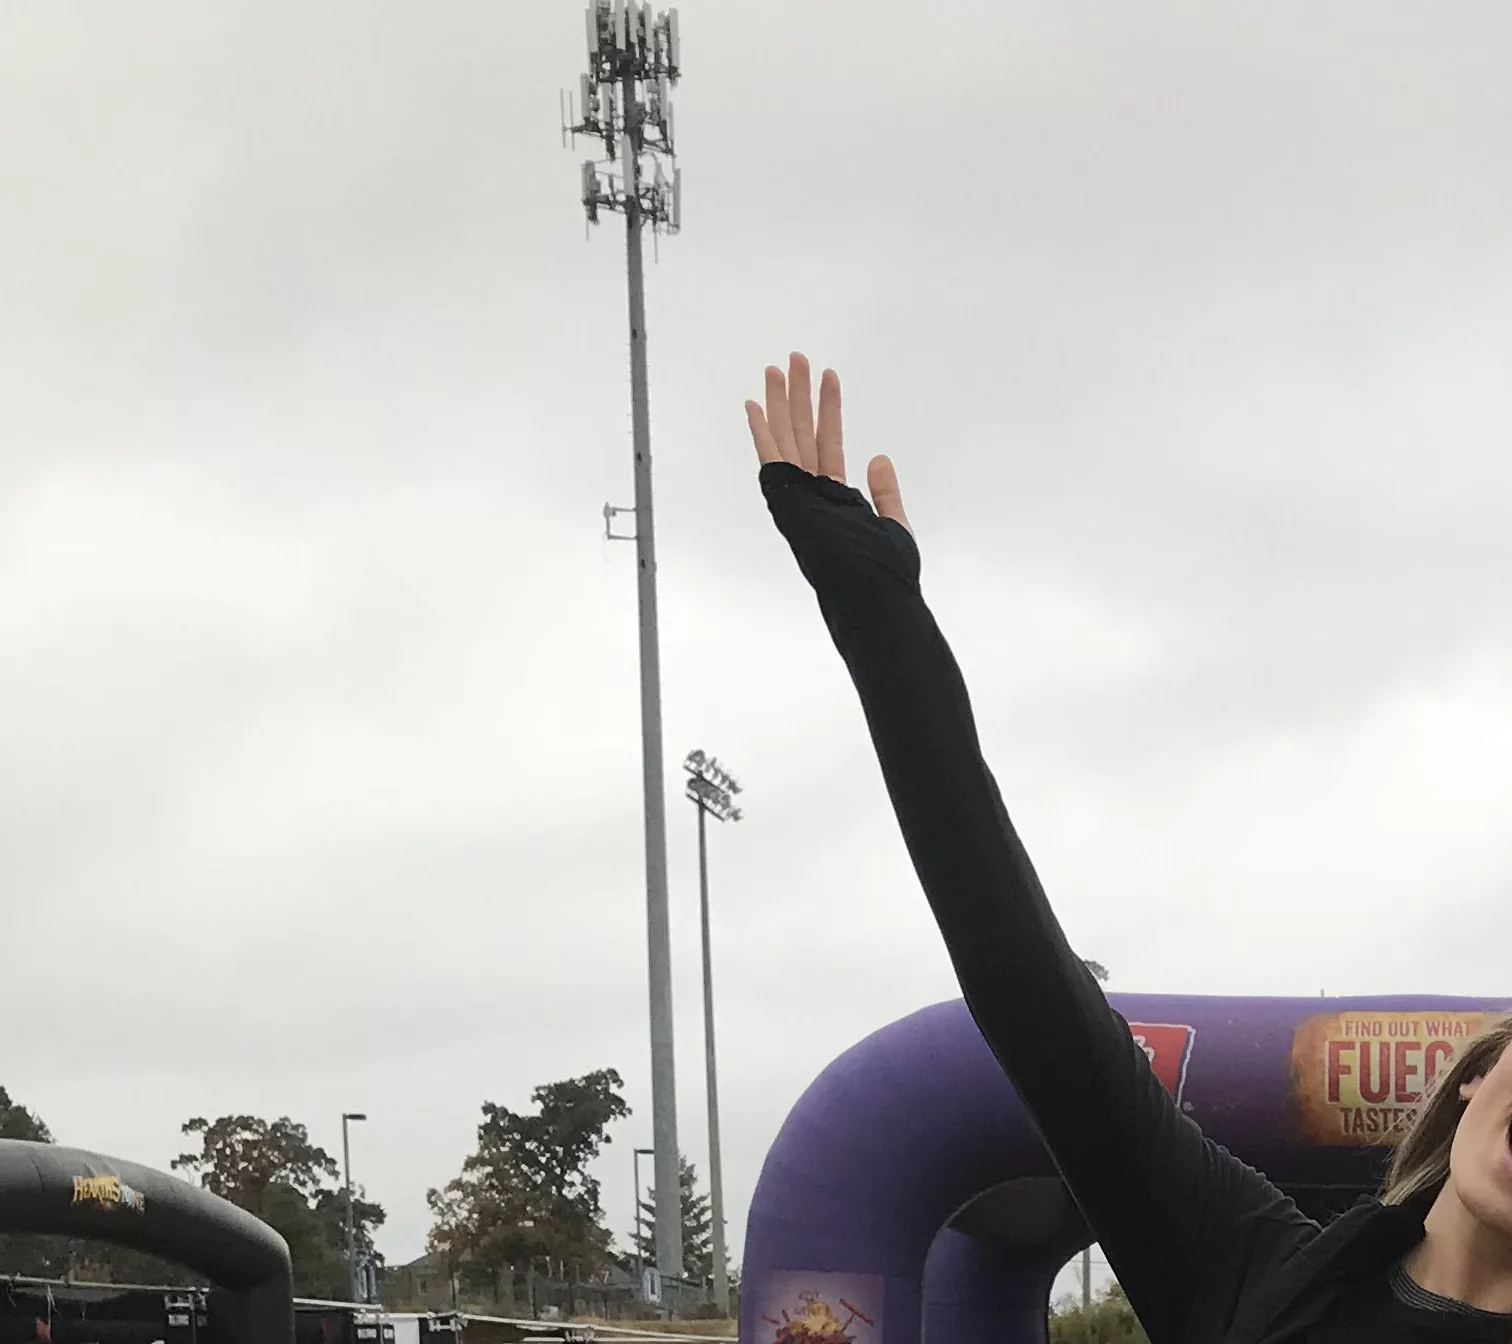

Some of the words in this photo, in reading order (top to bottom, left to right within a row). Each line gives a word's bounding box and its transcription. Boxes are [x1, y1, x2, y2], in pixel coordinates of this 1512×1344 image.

[1344, 1020, 1382, 1037] FIND
[1388, 1020, 1420, 1037] OUT
[1424, 1020, 1470, 1037] WHAT
